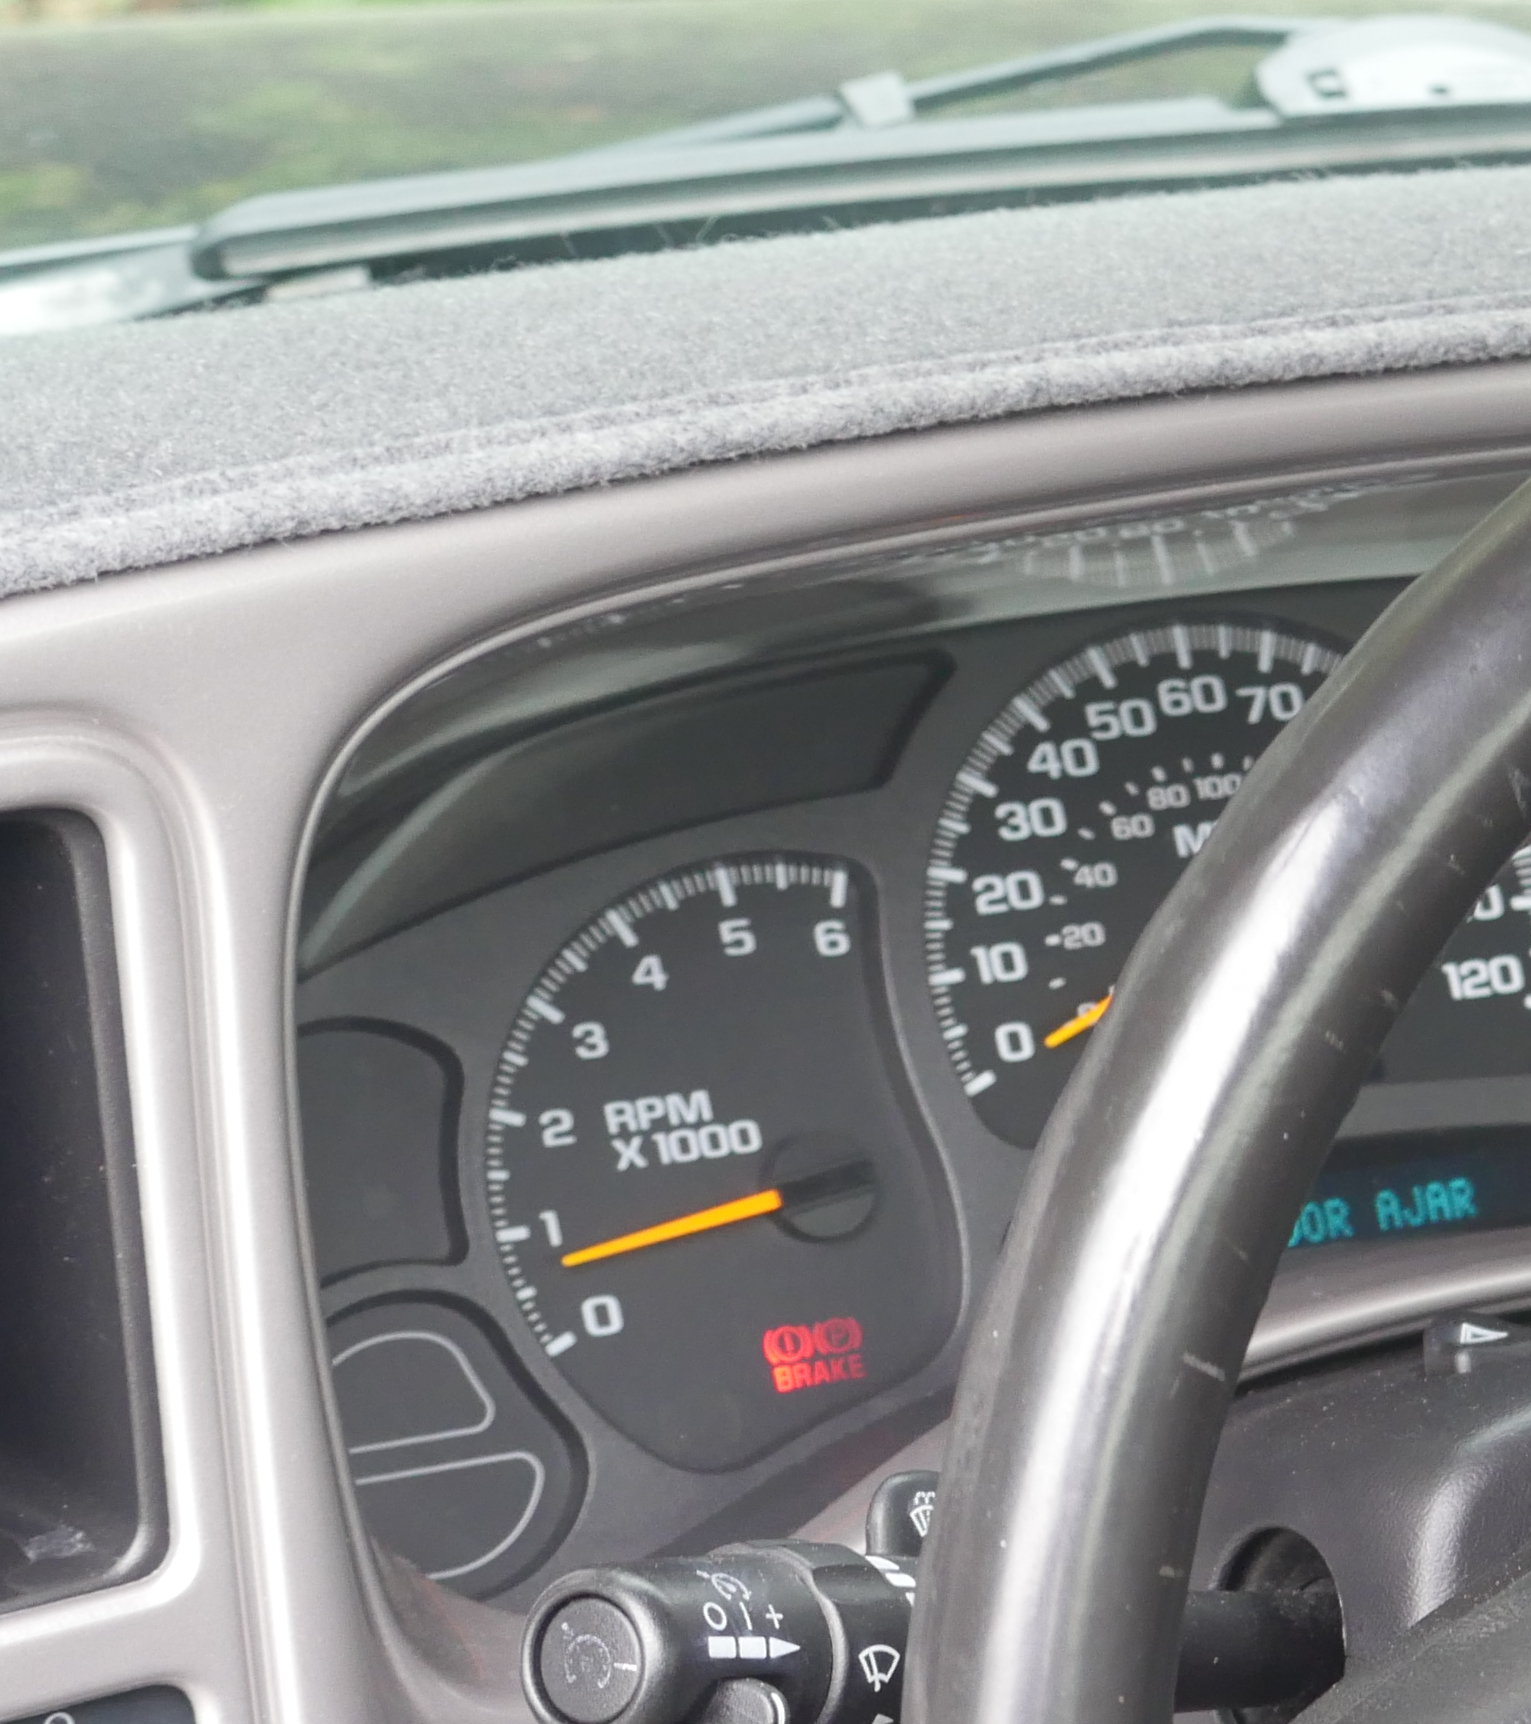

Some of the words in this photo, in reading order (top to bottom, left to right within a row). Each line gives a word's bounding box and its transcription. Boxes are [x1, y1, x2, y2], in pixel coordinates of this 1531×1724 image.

[1157, 675, 1228, 717] 60
[1236, 683, 1304, 724] 70
[1085, 698, 1157, 740] 50
[1027, 737, 1100, 780] 40
[1146, 784, 1191, 811] 80
[1193, 773, 1242, 800] 100
[994, 798, 1067, 841] 30
[1110, 814, 1155, 840] 60
[972, 870, 1044, 915] 20
[1073, 861, 1118, 888] 40
[718, 918, 757, 957] 5
[813, 919, 850, 957] 6
[1062, 922, 1106, 950] 20
[632, 954, 668, 991] 4
[970, 942, 1028, 984] 10
[1441, 954, 1525, 1001] 120
[572, 1021, 609, 1060] 3
[994, 1022, 1035, 1062] 0
[538, 1108, 576, 1148] 2
[604, 1089, 713, 1136] RPM
[1375, 1177, 1477, 1231] AJAR
[539, 1209, 563, 1248] 1
[581, 1295, 624, 1338] 0
[771, 1352, 866, 1394] BRAKE
